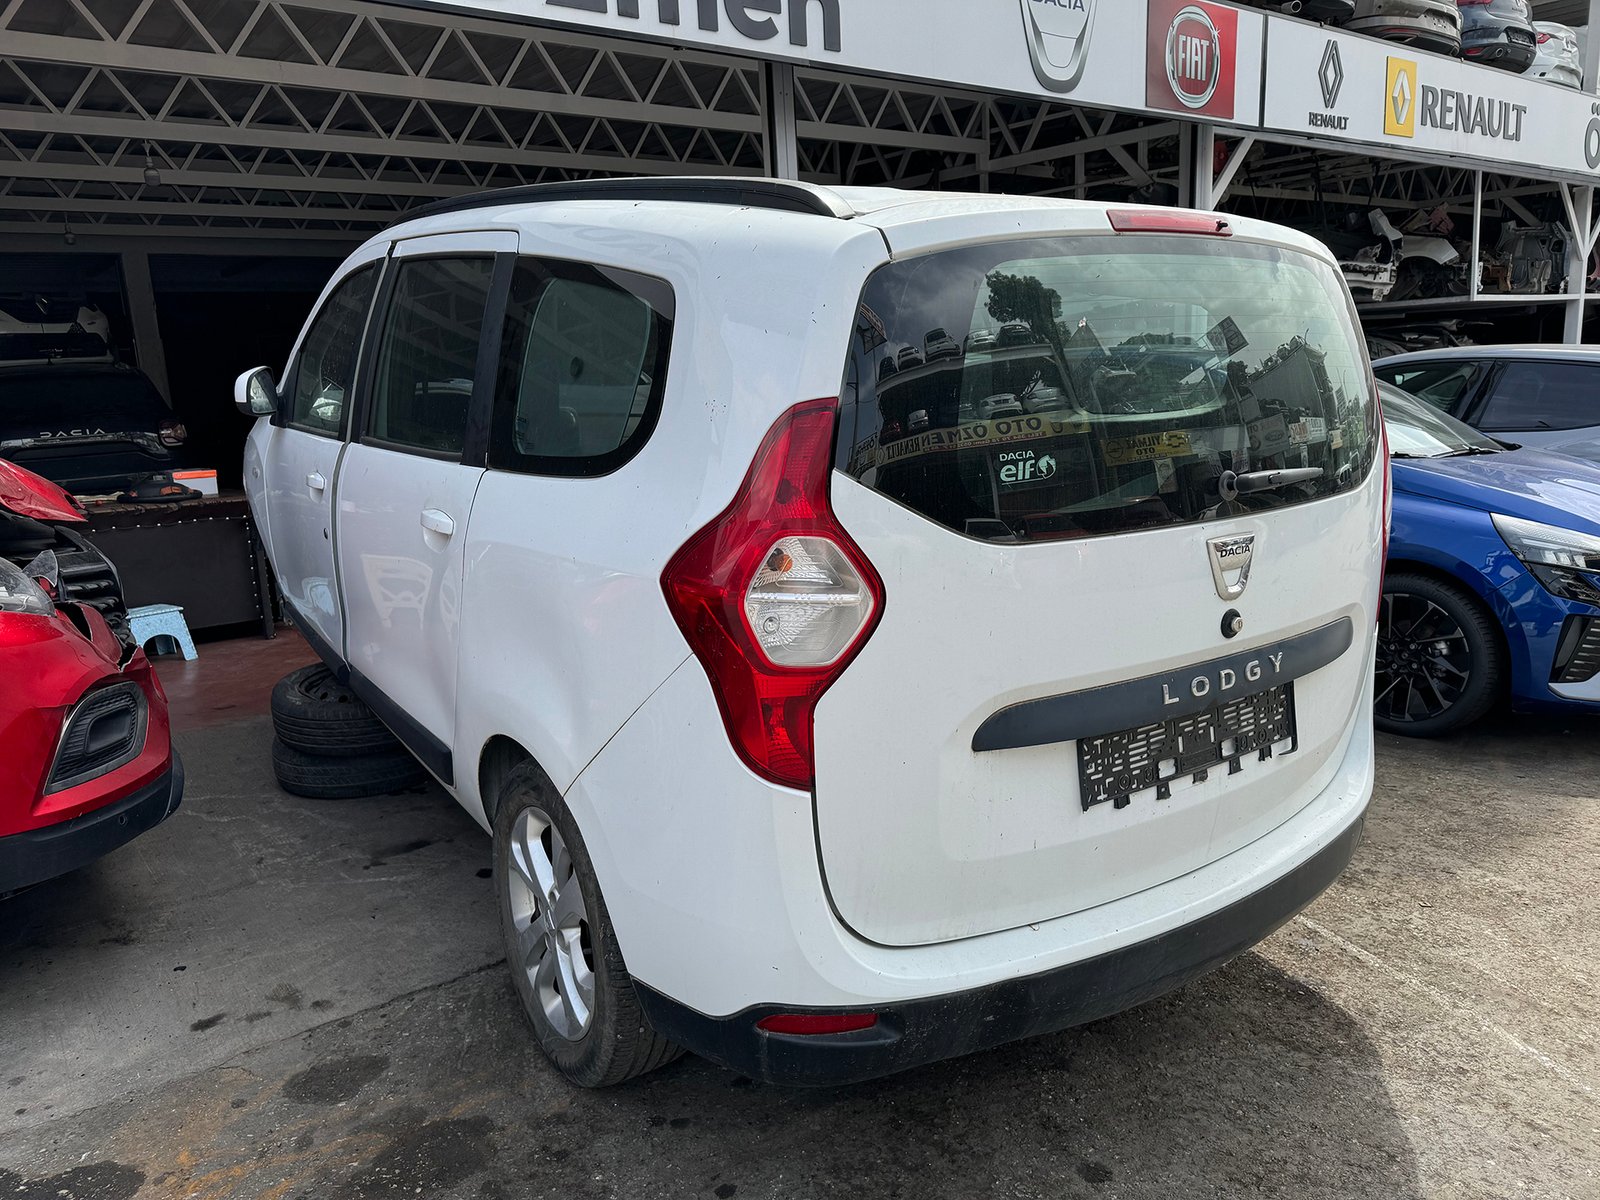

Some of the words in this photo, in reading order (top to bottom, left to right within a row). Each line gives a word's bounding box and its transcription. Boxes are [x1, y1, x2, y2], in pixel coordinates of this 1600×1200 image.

[1178, 34, 1210, 81] FIAT
[1308, 111, 1349, 130] RENAULT
[1420, 84, 1528, 142] RENAULT
[1000, 450, 1035, 462] DACIA
[1000, 459, 1036, 482] elf
[1220, 544, 1251, 558] DACIA
[1162, 651, 1283, 705] LODGY
